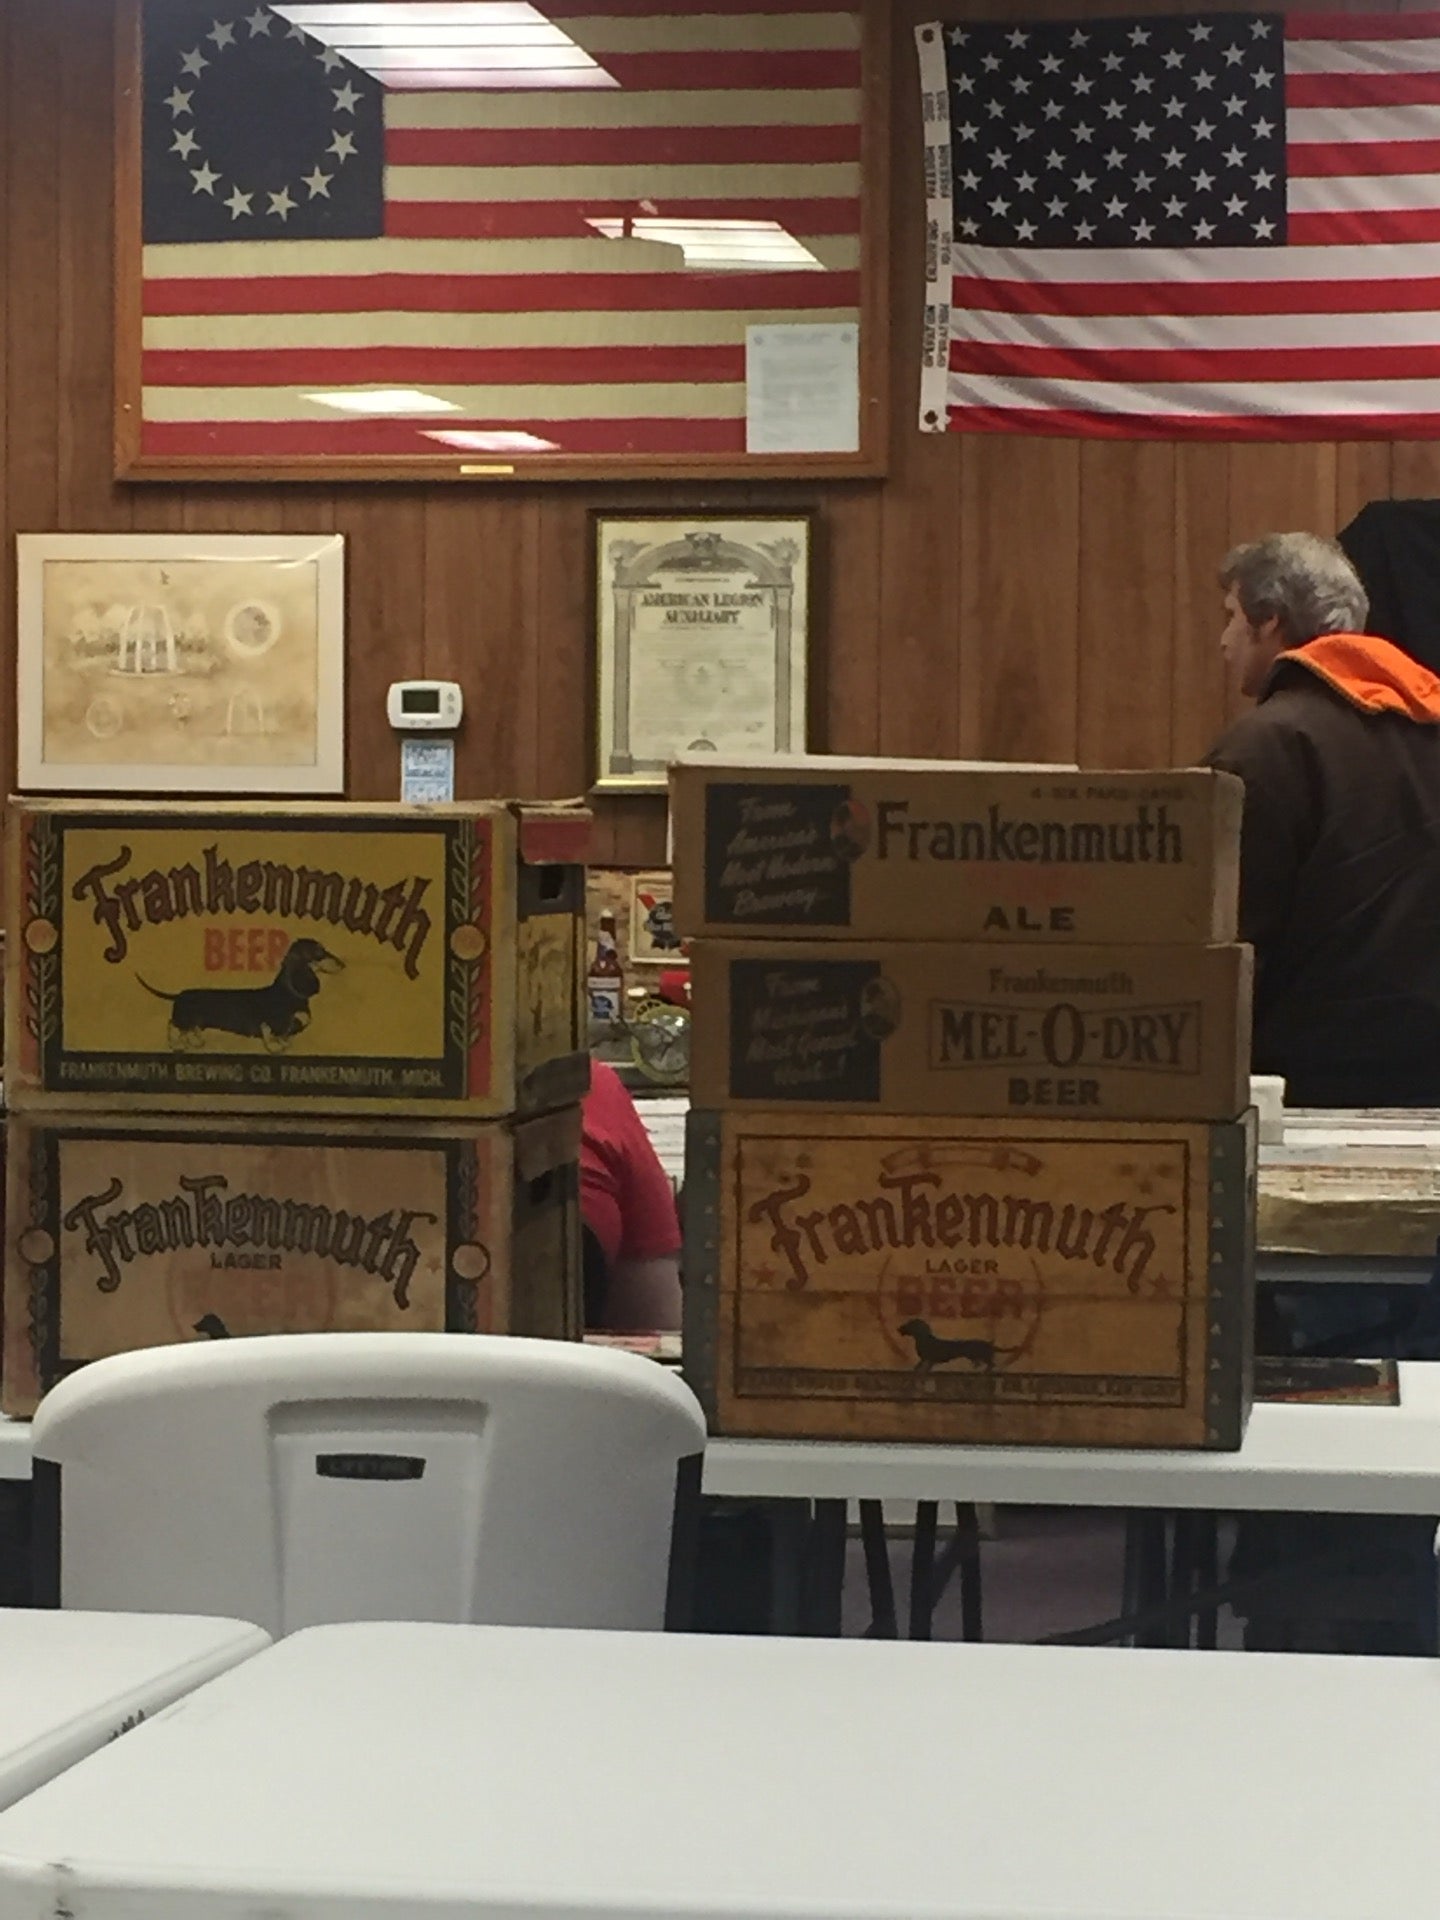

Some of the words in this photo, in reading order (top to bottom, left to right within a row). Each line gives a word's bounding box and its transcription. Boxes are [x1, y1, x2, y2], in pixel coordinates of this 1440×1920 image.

[876, 800, 1183, 863] Frankenmuth
[72, 843, 432, 980] Frankenmuth
[983, 906, 1075, 932] ALE
[203, 927, 290, 972] BEER
[988, 968, 1133, 995] Frankenmuth
[938, 1002, 1190, 1068] MEL-O-DRY
[60, 1061, 168, 1080] FRANKENMUTH
[175, 1063, 244, 1082] BREWING
[1008, 1077, 1100, 1106] BEER
[64, 1175, 437, 1310] Frankenmuth
[749, 1171, 1177, 1294] Frankenmuth
[210, 1252, 281, 1270] LAGER
[924, 1258, 999, 1275] LAGER
[896, 1275, 1024, 1319] BEER
